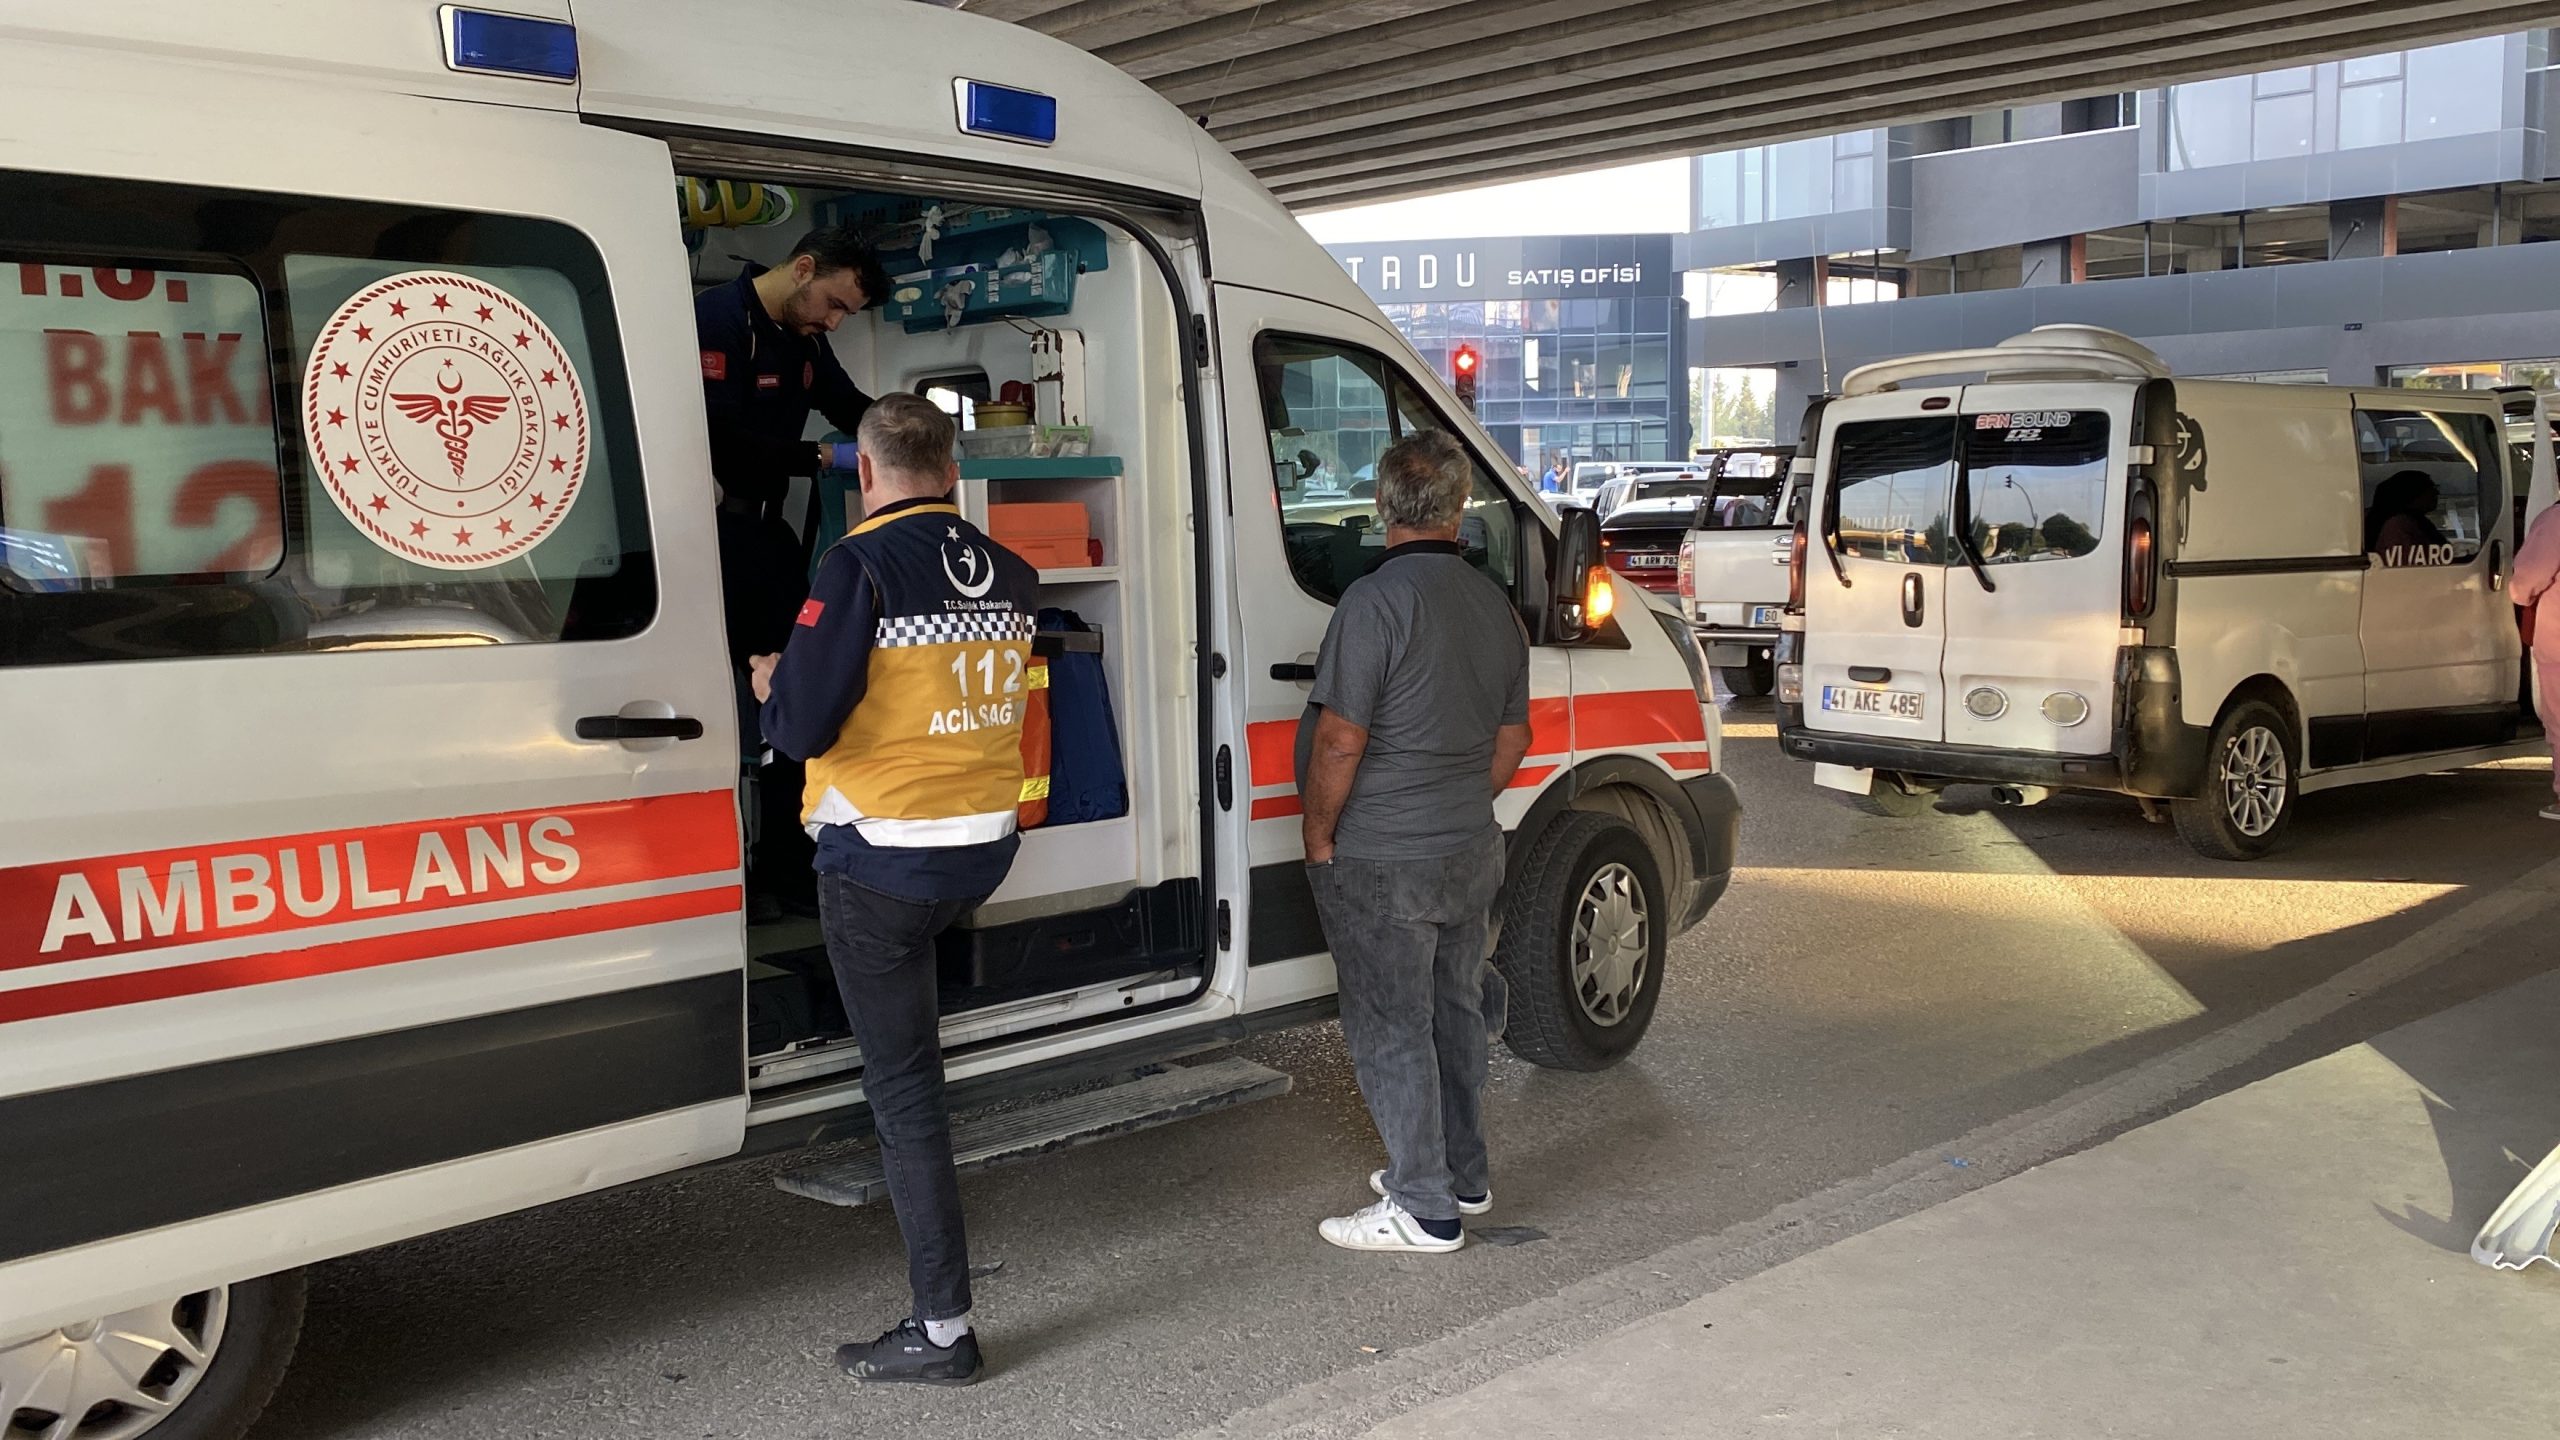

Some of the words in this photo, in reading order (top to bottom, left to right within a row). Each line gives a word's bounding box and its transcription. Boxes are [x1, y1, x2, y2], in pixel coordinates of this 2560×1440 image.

[1346, 252, 1475, 290] TADU
[1507, 268, 1576, 288] SATIŞ
[1580, 263, 1641, 284] OFİSİ
[364, 328, 461, 411] CUMHURİYETİ
[468, 335, 527, 390] SAĞLIK
[364, 419, 420, 498] TÜRKİYE
[499, 395, 539, 495] BAKANLIĞI
[2, 459, 285, 584] 12
[1631, 555, 1642, 565] 41
[1764, 610, 1777, 621] 60
[951, 649, 1022, 697] 112
[928, 701, 980, 736] ACİL
[979, 697, 1016, 727] SAĞ
[1831, 689, 1846, 709] 41
[1853, 691, 1882, 712] AKE
[1889, 694, 1918, 715] 485
[40, 817, 580, 953] AMBULANS
